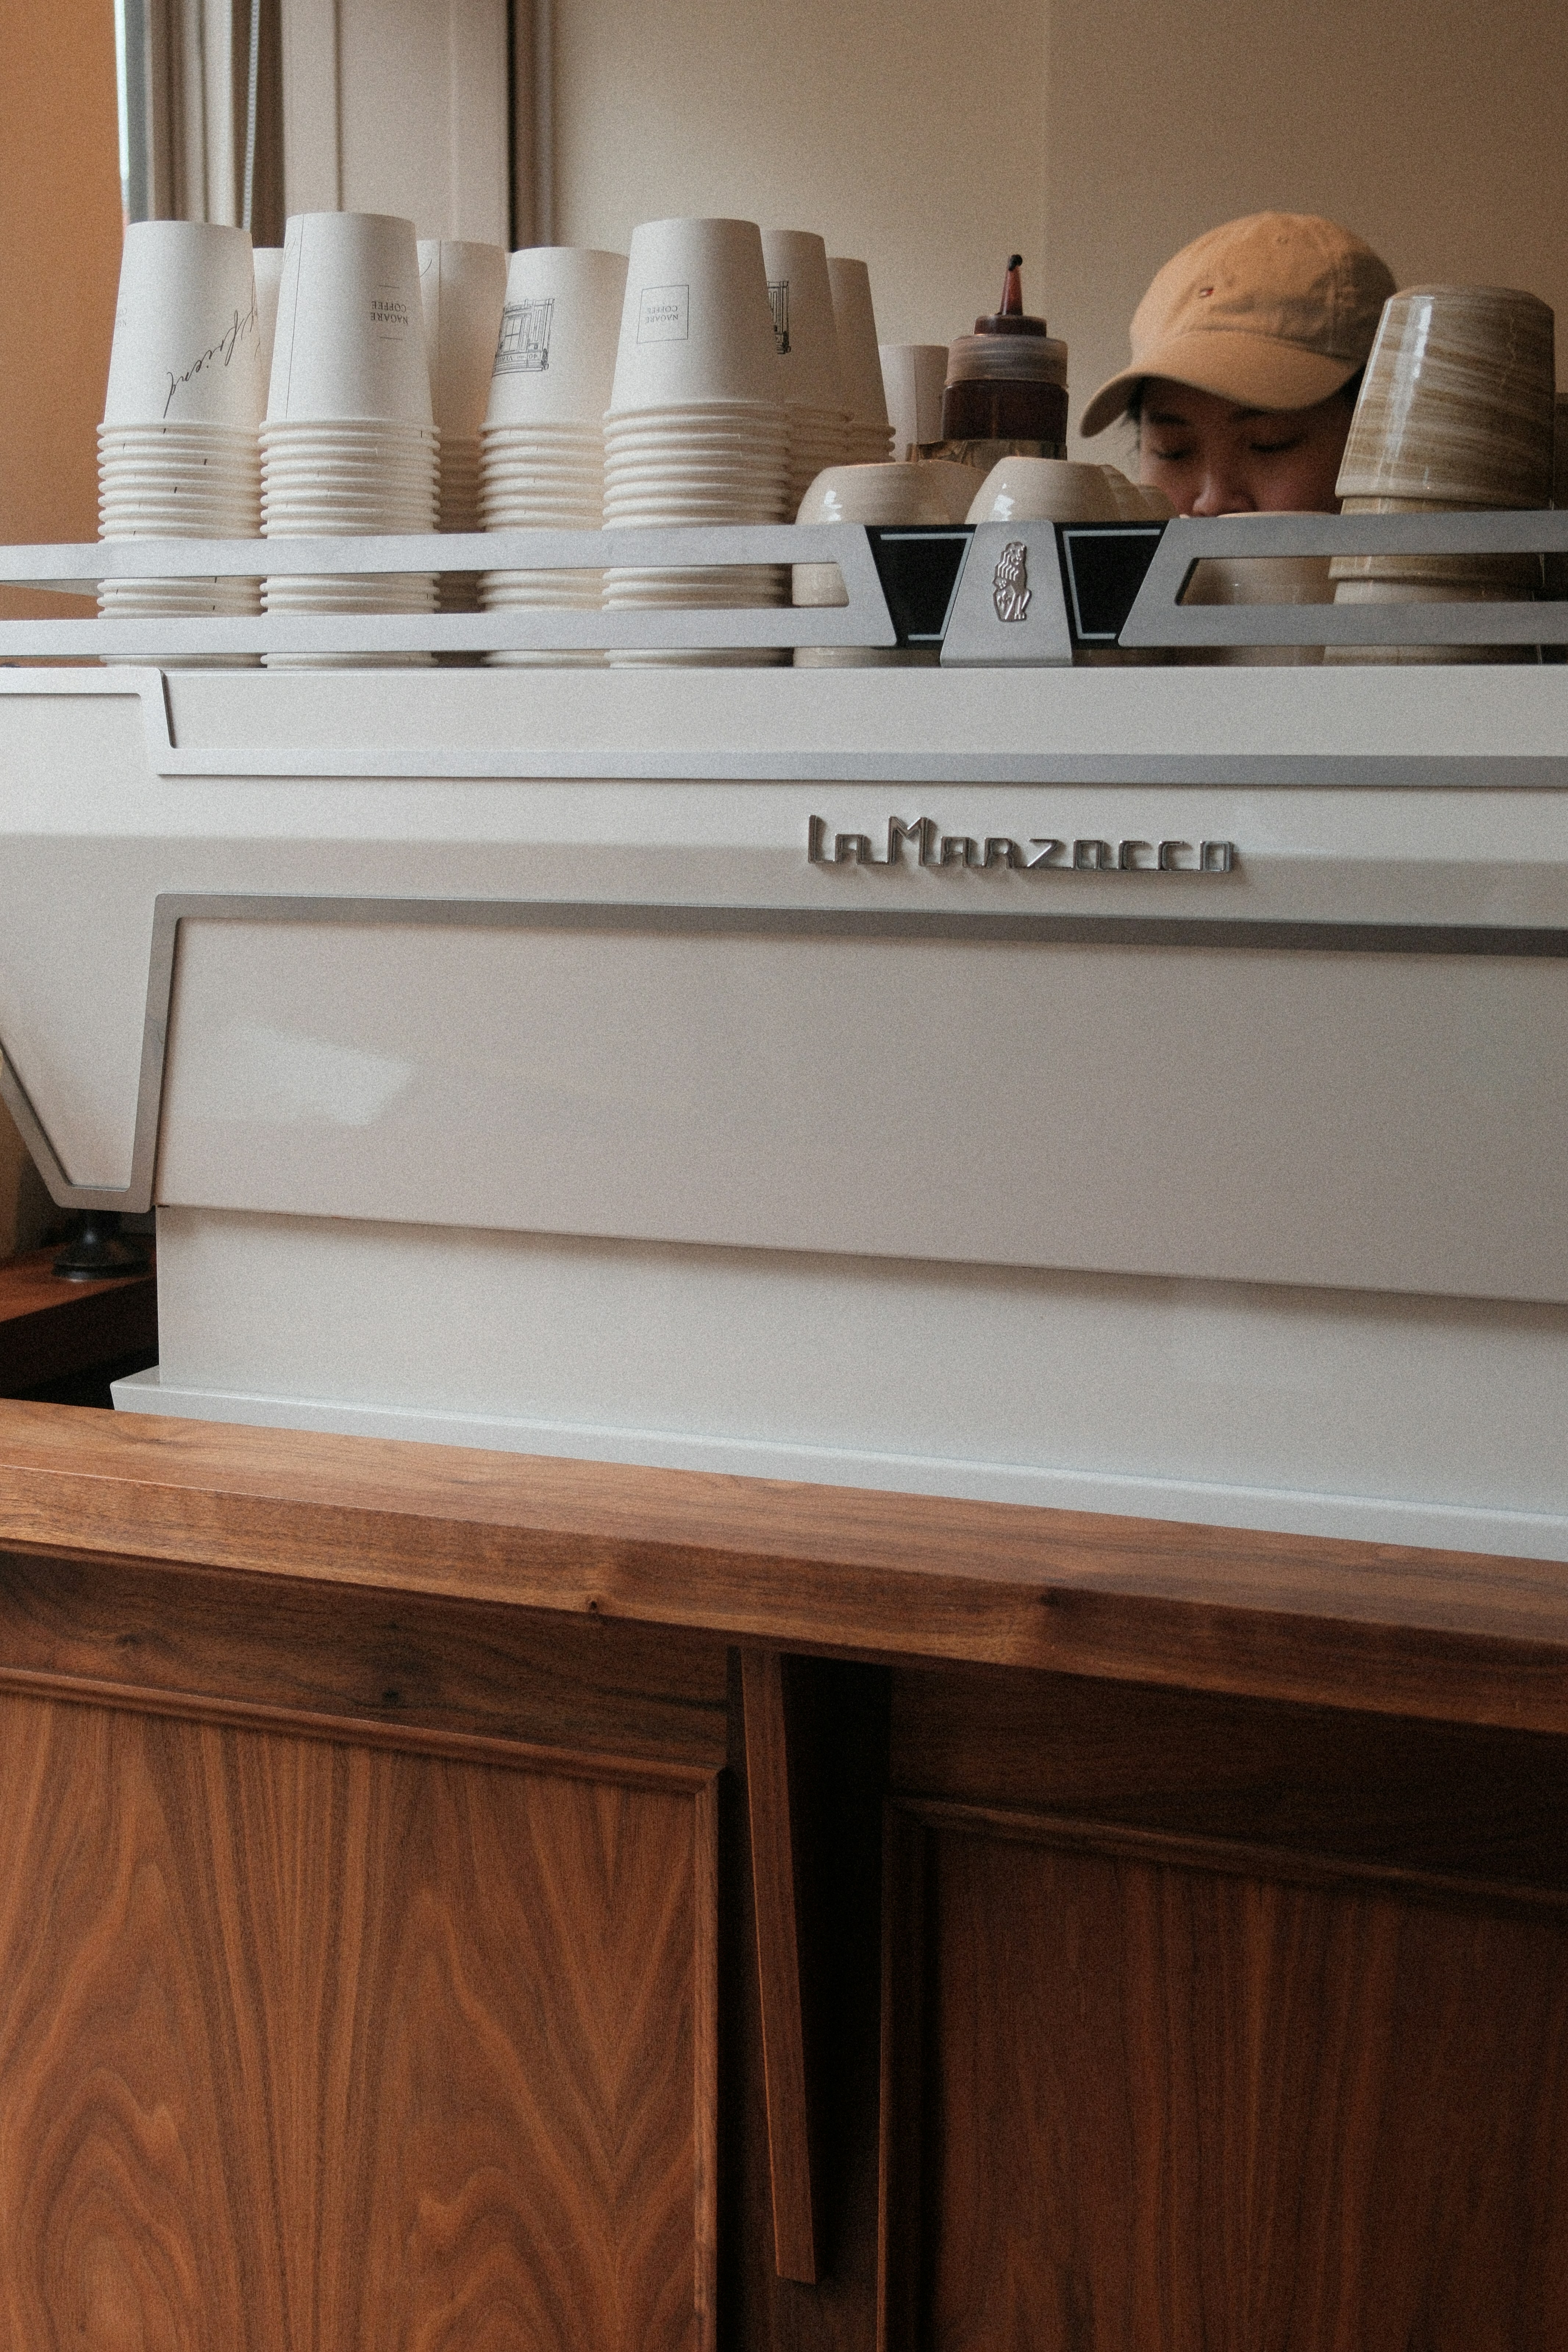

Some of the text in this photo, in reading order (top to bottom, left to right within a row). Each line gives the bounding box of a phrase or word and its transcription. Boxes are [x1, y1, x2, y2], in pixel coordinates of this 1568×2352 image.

[371, 301, 406, 313] COFFEE
[647, 305, 678, 314] COFFEE
[370, 312, 408, 325] NAGARE
